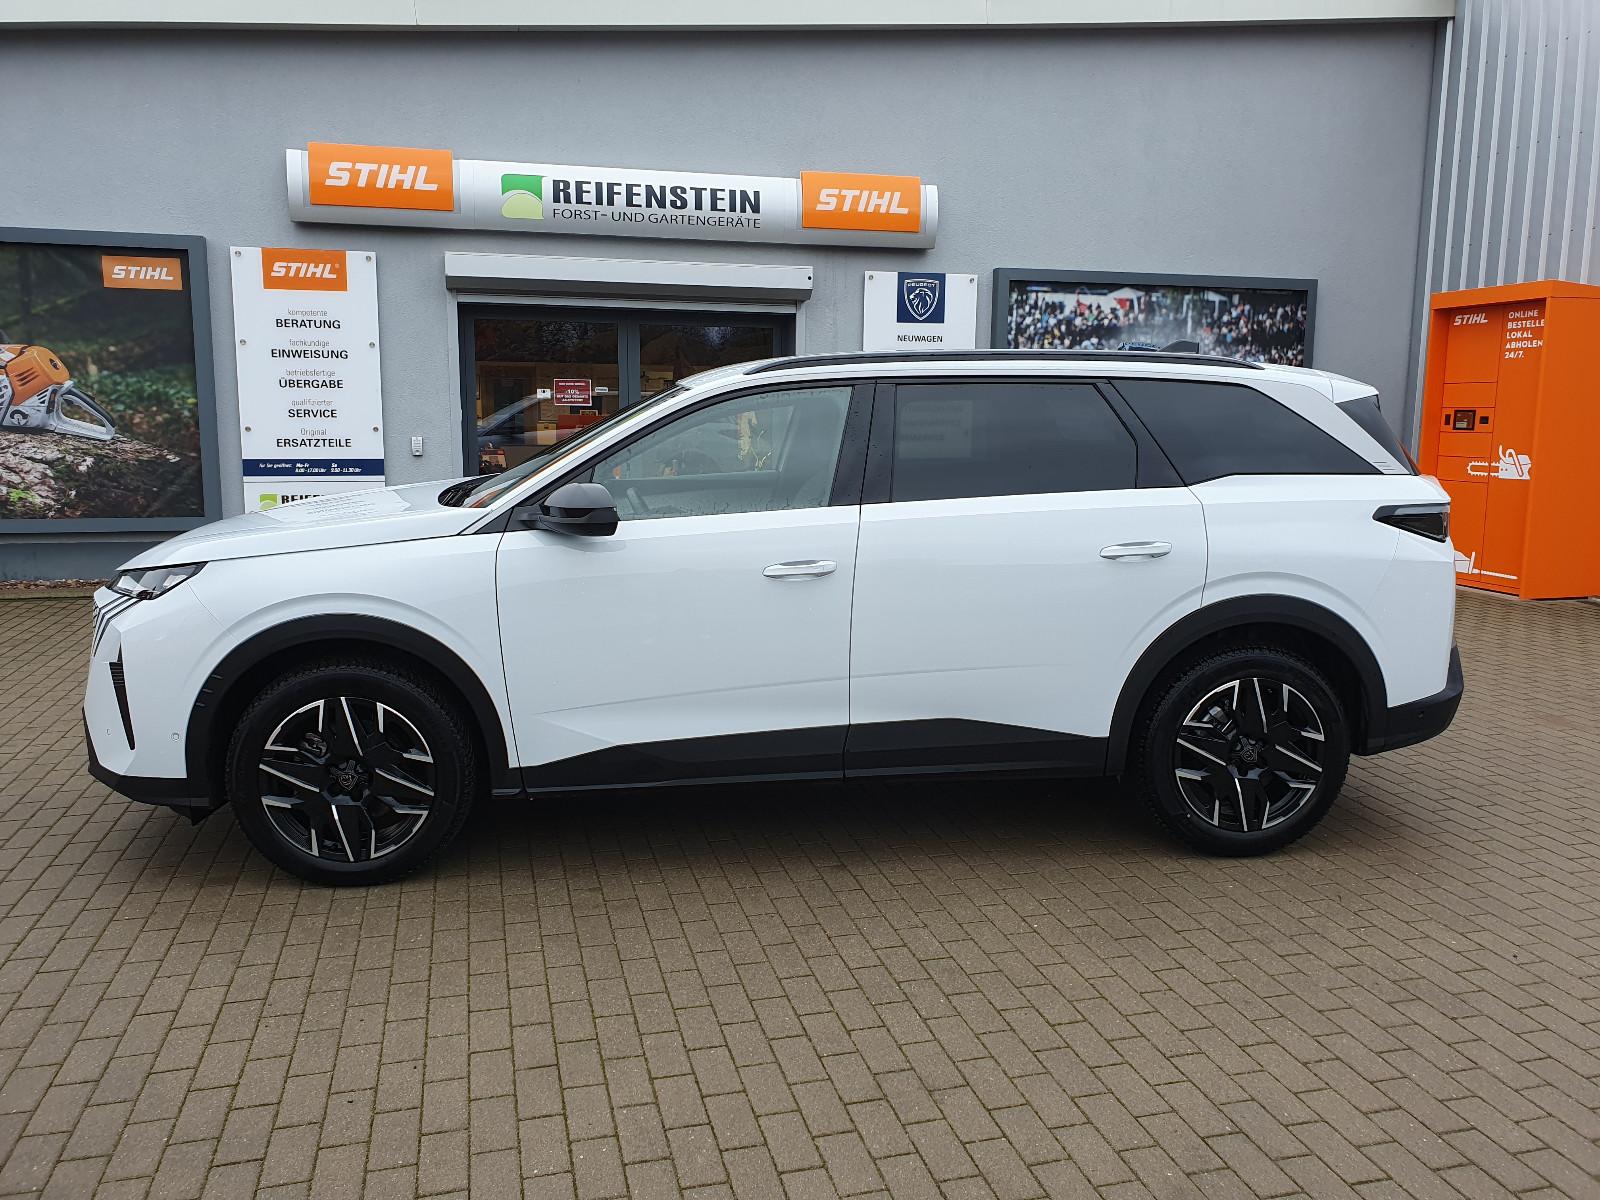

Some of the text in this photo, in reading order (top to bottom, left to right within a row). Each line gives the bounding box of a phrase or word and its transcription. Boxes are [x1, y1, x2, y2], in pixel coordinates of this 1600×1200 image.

[324, 161, 438, 191] STIHL
[552, 179, 760, 214] REIFENSTEIN
[815, 188, 909, 215] STIHL
[553, 208, 761, 229] FORST- UND GARTENGERÄTE
[111, 265, 174, 281] STIHL
[270, 261, 337, 279] STIHL
[288, 308, 328, 317] kompetente
[1508, 309, 1539, 319] ONLINE
[275, 318, 341, 329] BERATUNG
[1453, 313, 1488, 326] STIHL
[1507, 319, 1545, 329] BESTELLE
[897, 334, 943, 343] NEUWAGEN
[1506, 330, 1533, 339] LOKAL
[289, 339, 330, 349] fachkundige
[1505, 340, 1543, 349] ABHOLEN
[271, 348, 349, 360] EINWEISUNG
[1504, 350, 1524, 359] 24/7.
[286, 369, 336, 378] betriebsfertige
[278, 377, 344, 389] ÜBERGABE
[291, 398, 333, 407] qualifizierter
[288, 408, 338, 418] SERVICE
[300, 428, 327, 437] Original
[276, 438, 352, 448] ERSATZTEILE
